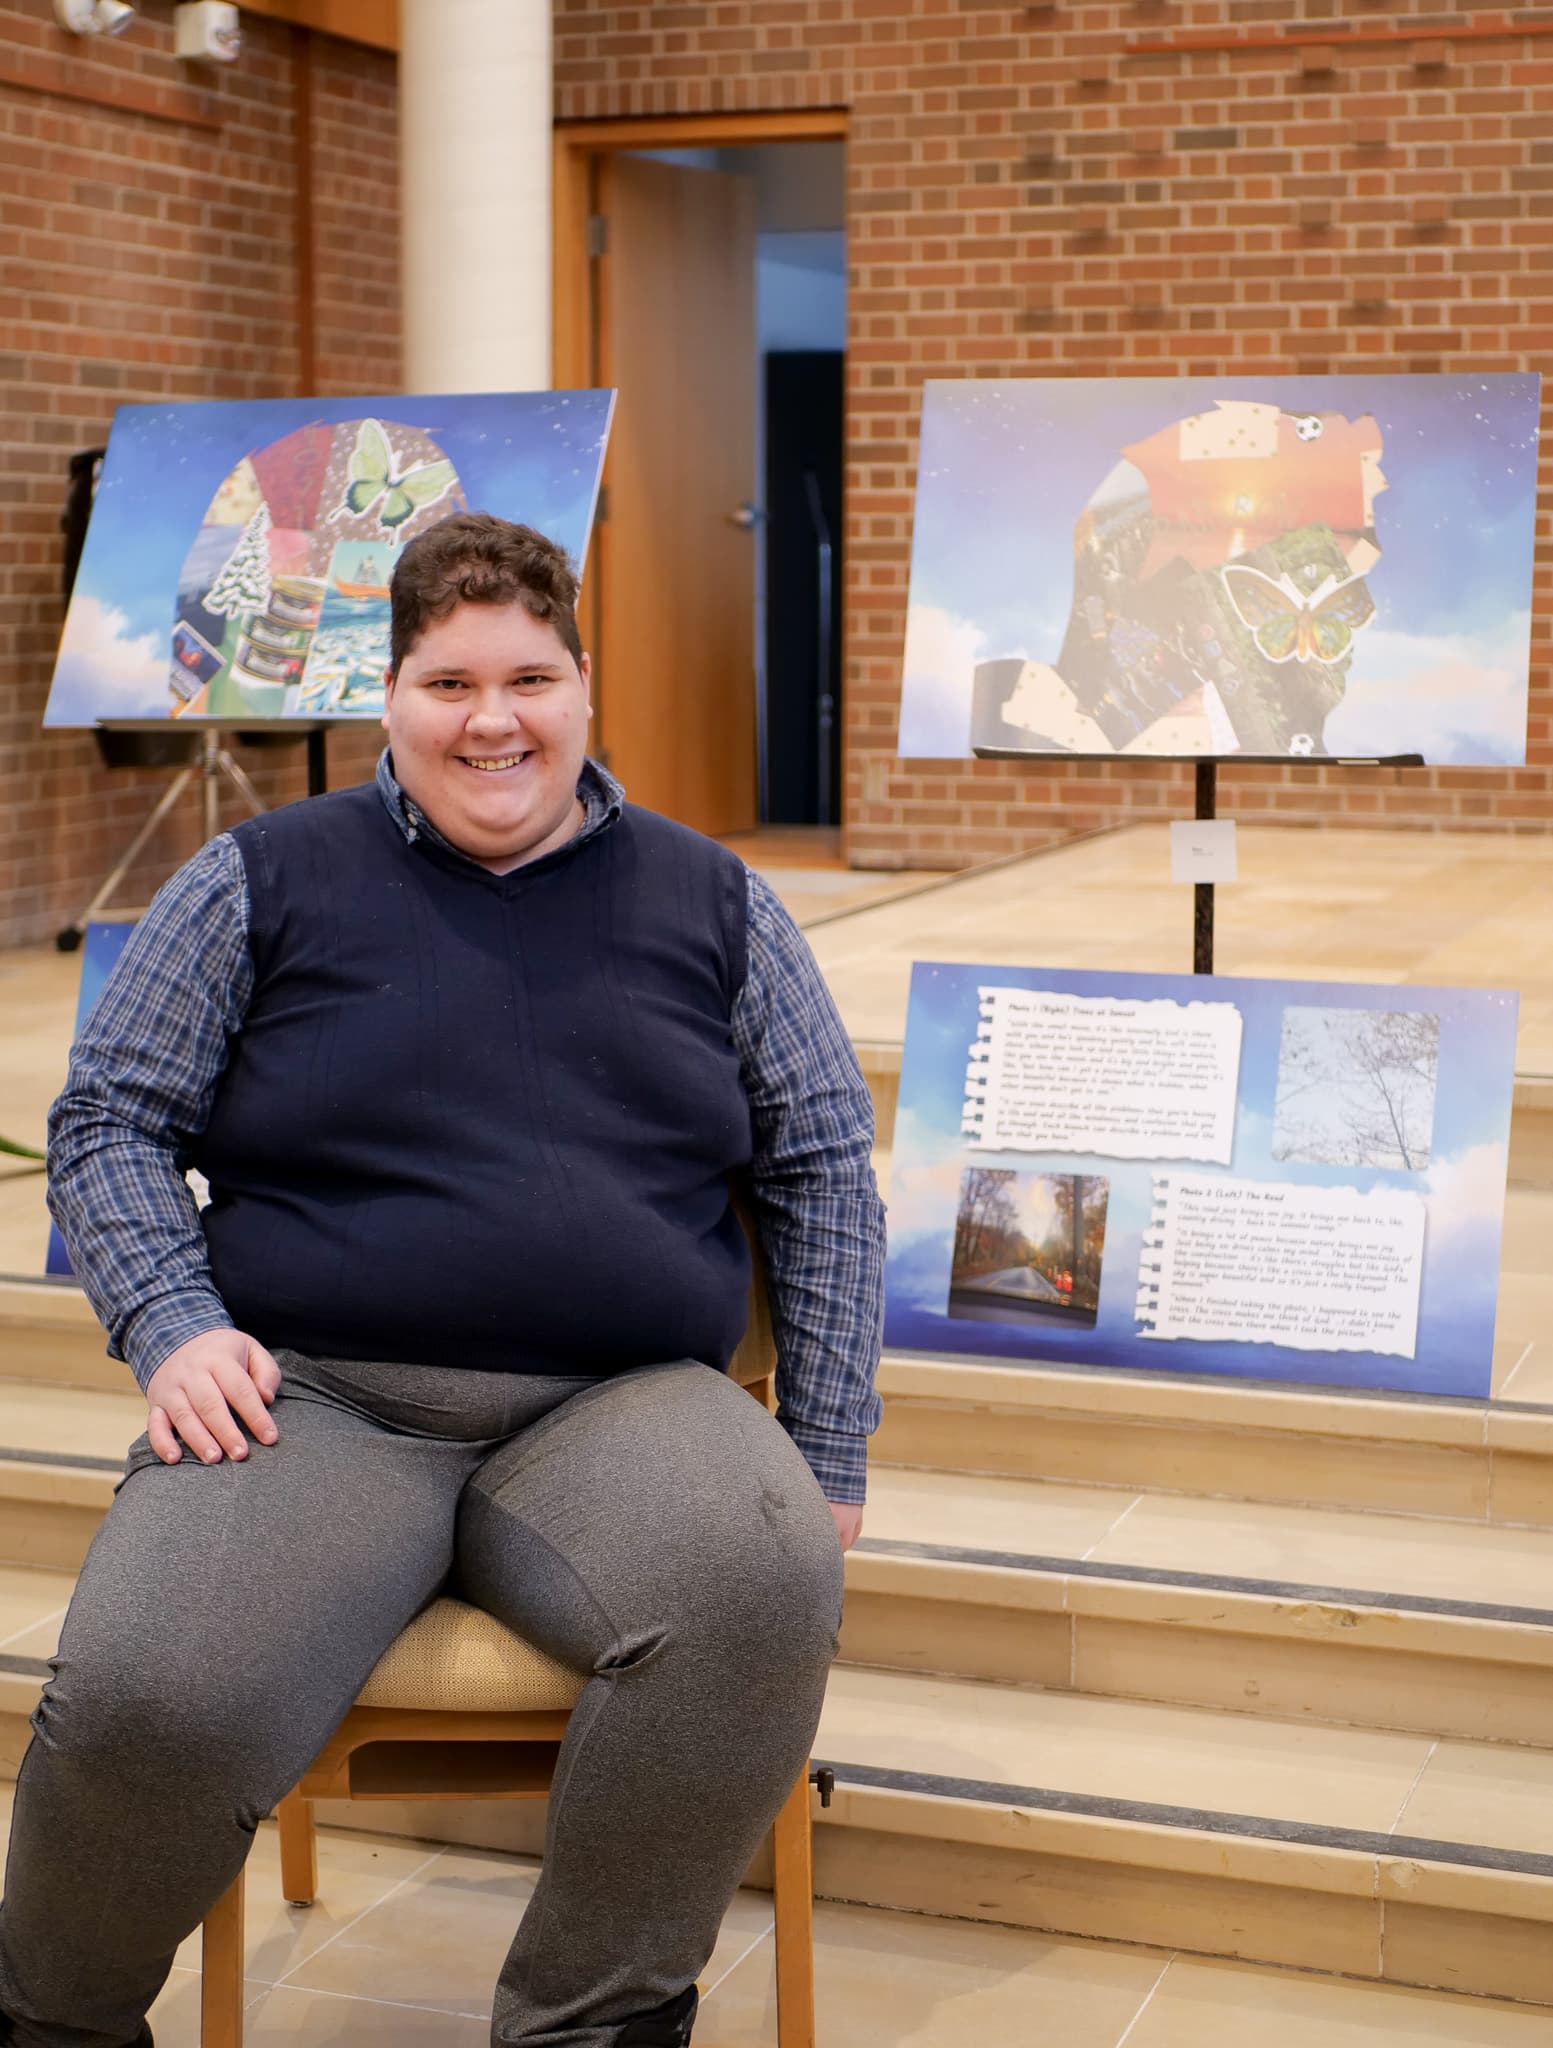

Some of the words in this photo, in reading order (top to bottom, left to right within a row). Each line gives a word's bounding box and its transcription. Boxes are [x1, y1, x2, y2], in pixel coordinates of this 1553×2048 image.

[1180, 1187, 1202, 1196] Photo
[1206, 1188, 1211, 1197] 2
[1215, 1189, 1241, 1200] (Left)
[1246, 1191, 1260, 1200] The
[1264, 1193, 1284, 1202] Road
